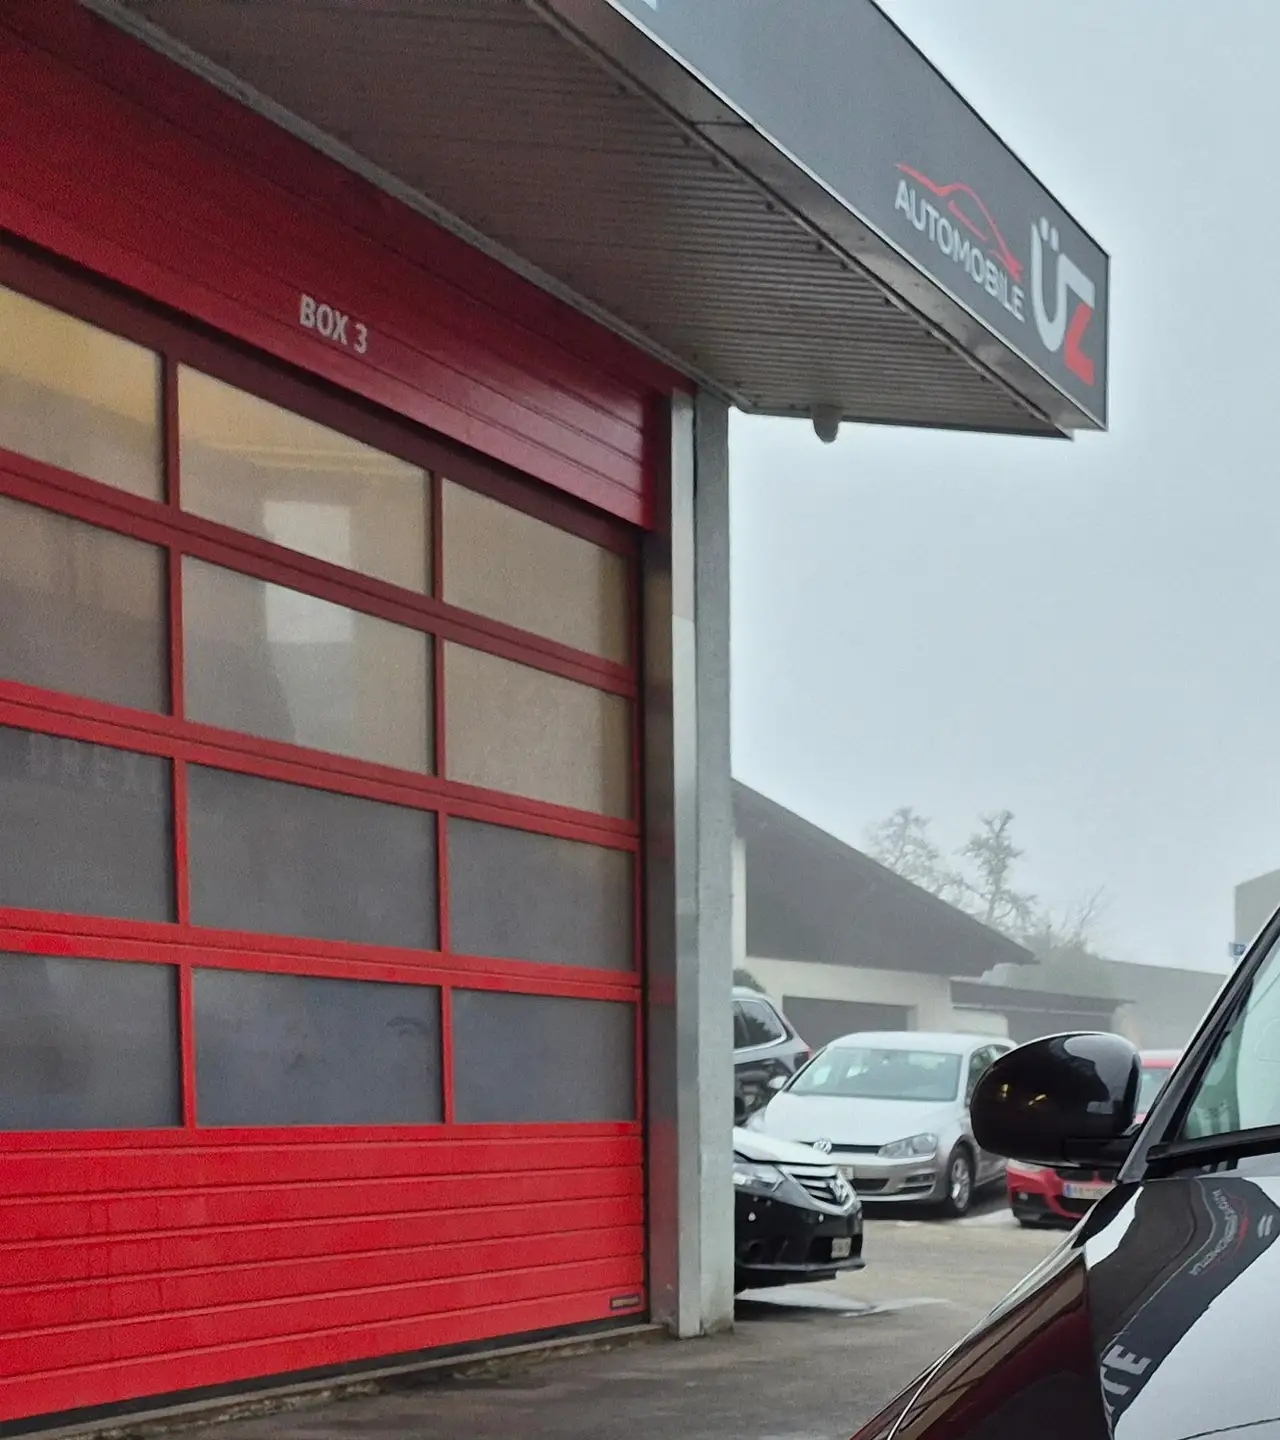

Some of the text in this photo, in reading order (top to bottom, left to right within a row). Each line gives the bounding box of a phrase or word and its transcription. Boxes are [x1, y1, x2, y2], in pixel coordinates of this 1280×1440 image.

[299, 293, 368, 354] BOX 3
[894, 179, 1096, 387] AUTOMOBILE ÜZ
